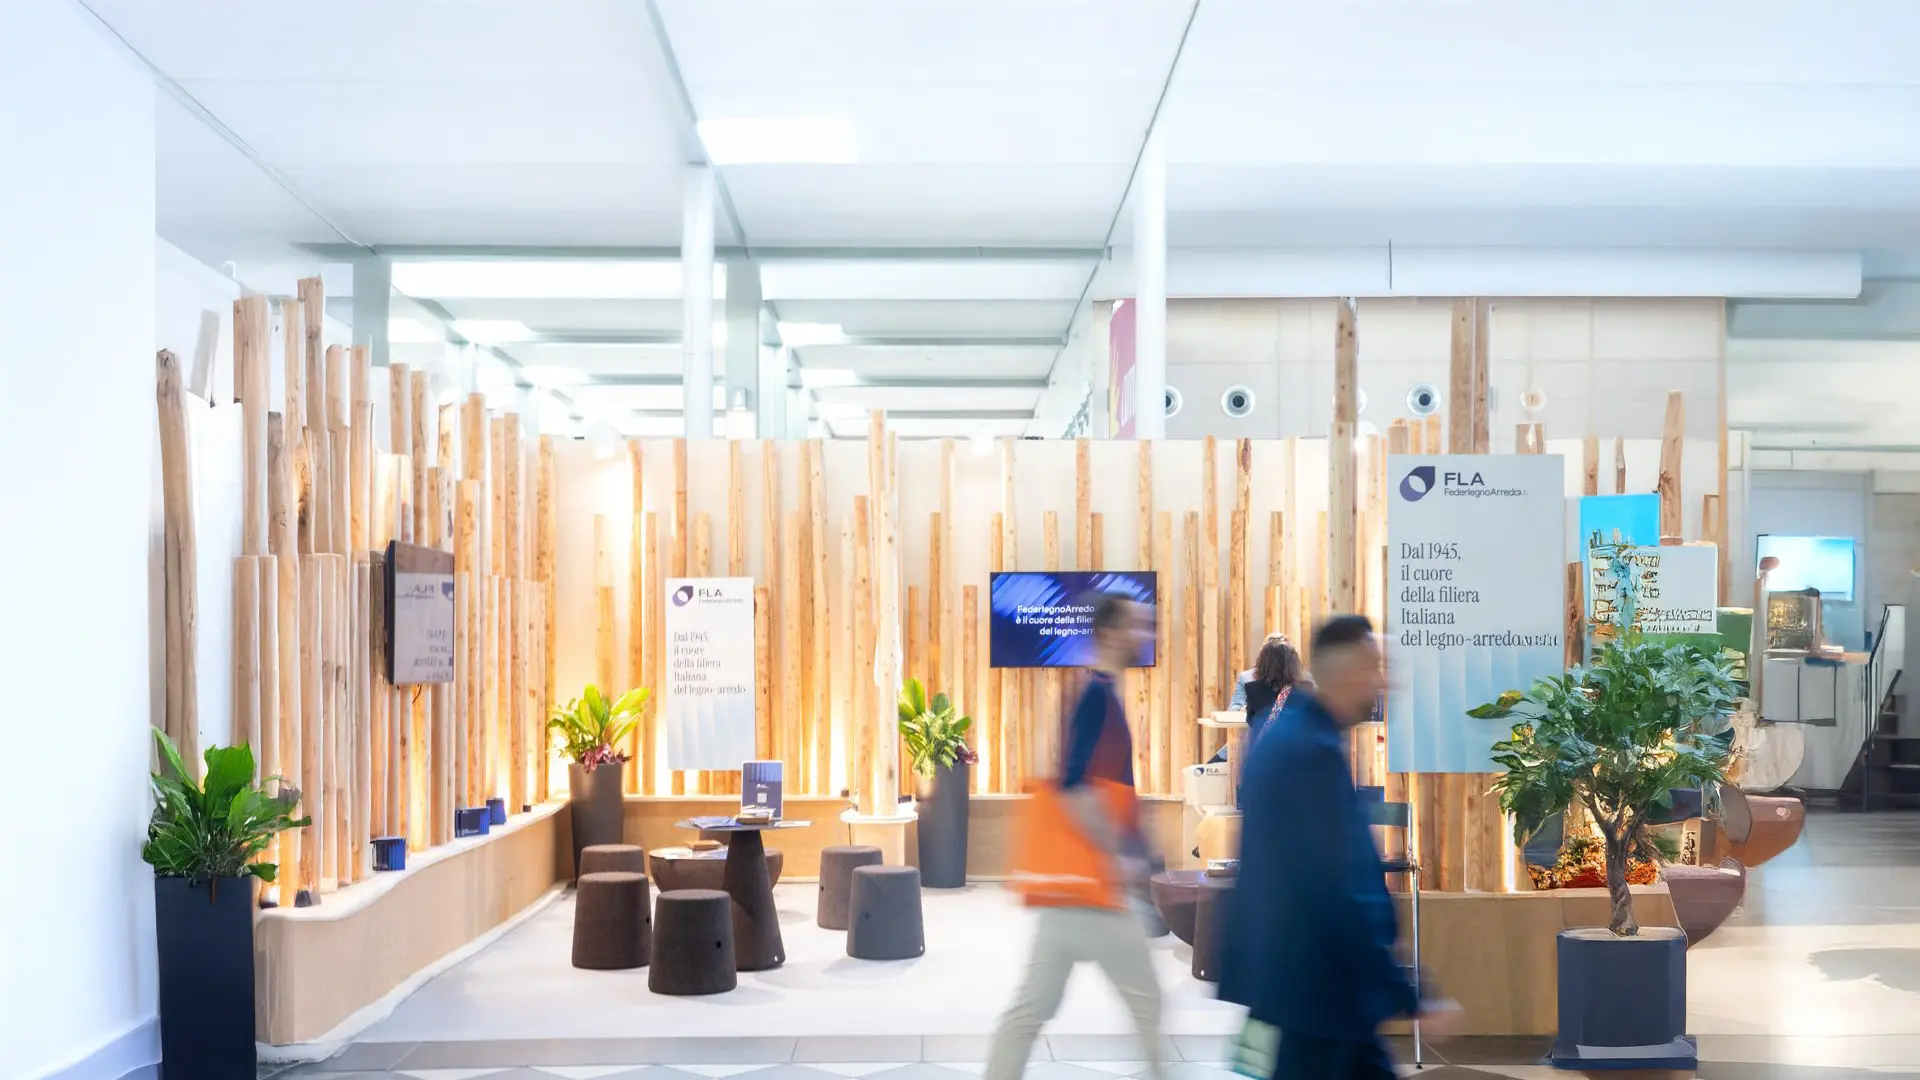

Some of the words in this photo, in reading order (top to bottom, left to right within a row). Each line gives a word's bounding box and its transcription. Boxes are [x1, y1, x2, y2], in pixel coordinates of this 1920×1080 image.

[1443, 472, 1485, 487] FLA
[1443, 488, 1523, 499] FederlegnoArredo
[1401, 542, 1424, 560] Dal
[1429, 542, 1462, 562] 1945,
[1401, 564, 1410, 582] il
[1413, 568, 1453, 582] cuore
[698, 589, 723, 597] FLA
[1400, 586, 1435, 603] della
[1438, 586, 1480, 603] filiera
[1017, 605, 1095, 615] FederlegnoArredo
[1016, 616, 1022, 624] è
[1023, 616, 1028, 624] il
[1054, 616, 1075, 624] della
[1401, 608, 1455, 625] Italiana
[674, 631, 688, 642] Dal
[1040, 627, 1053, 635] del
[1400, 630, 1422, 647] del
[1426, 630, 1521, 651] legno-arredo
[674, 645, 679, 656] il
[681, 646, 705, 656] cuore
[673, 657, 695, 669] della
[696, 657, 722, 669] filiera
[673, 671, 707, 682] Italiana
[673, 684, 687, 696] del
[689, 684, 747, 697] legno-arredo
